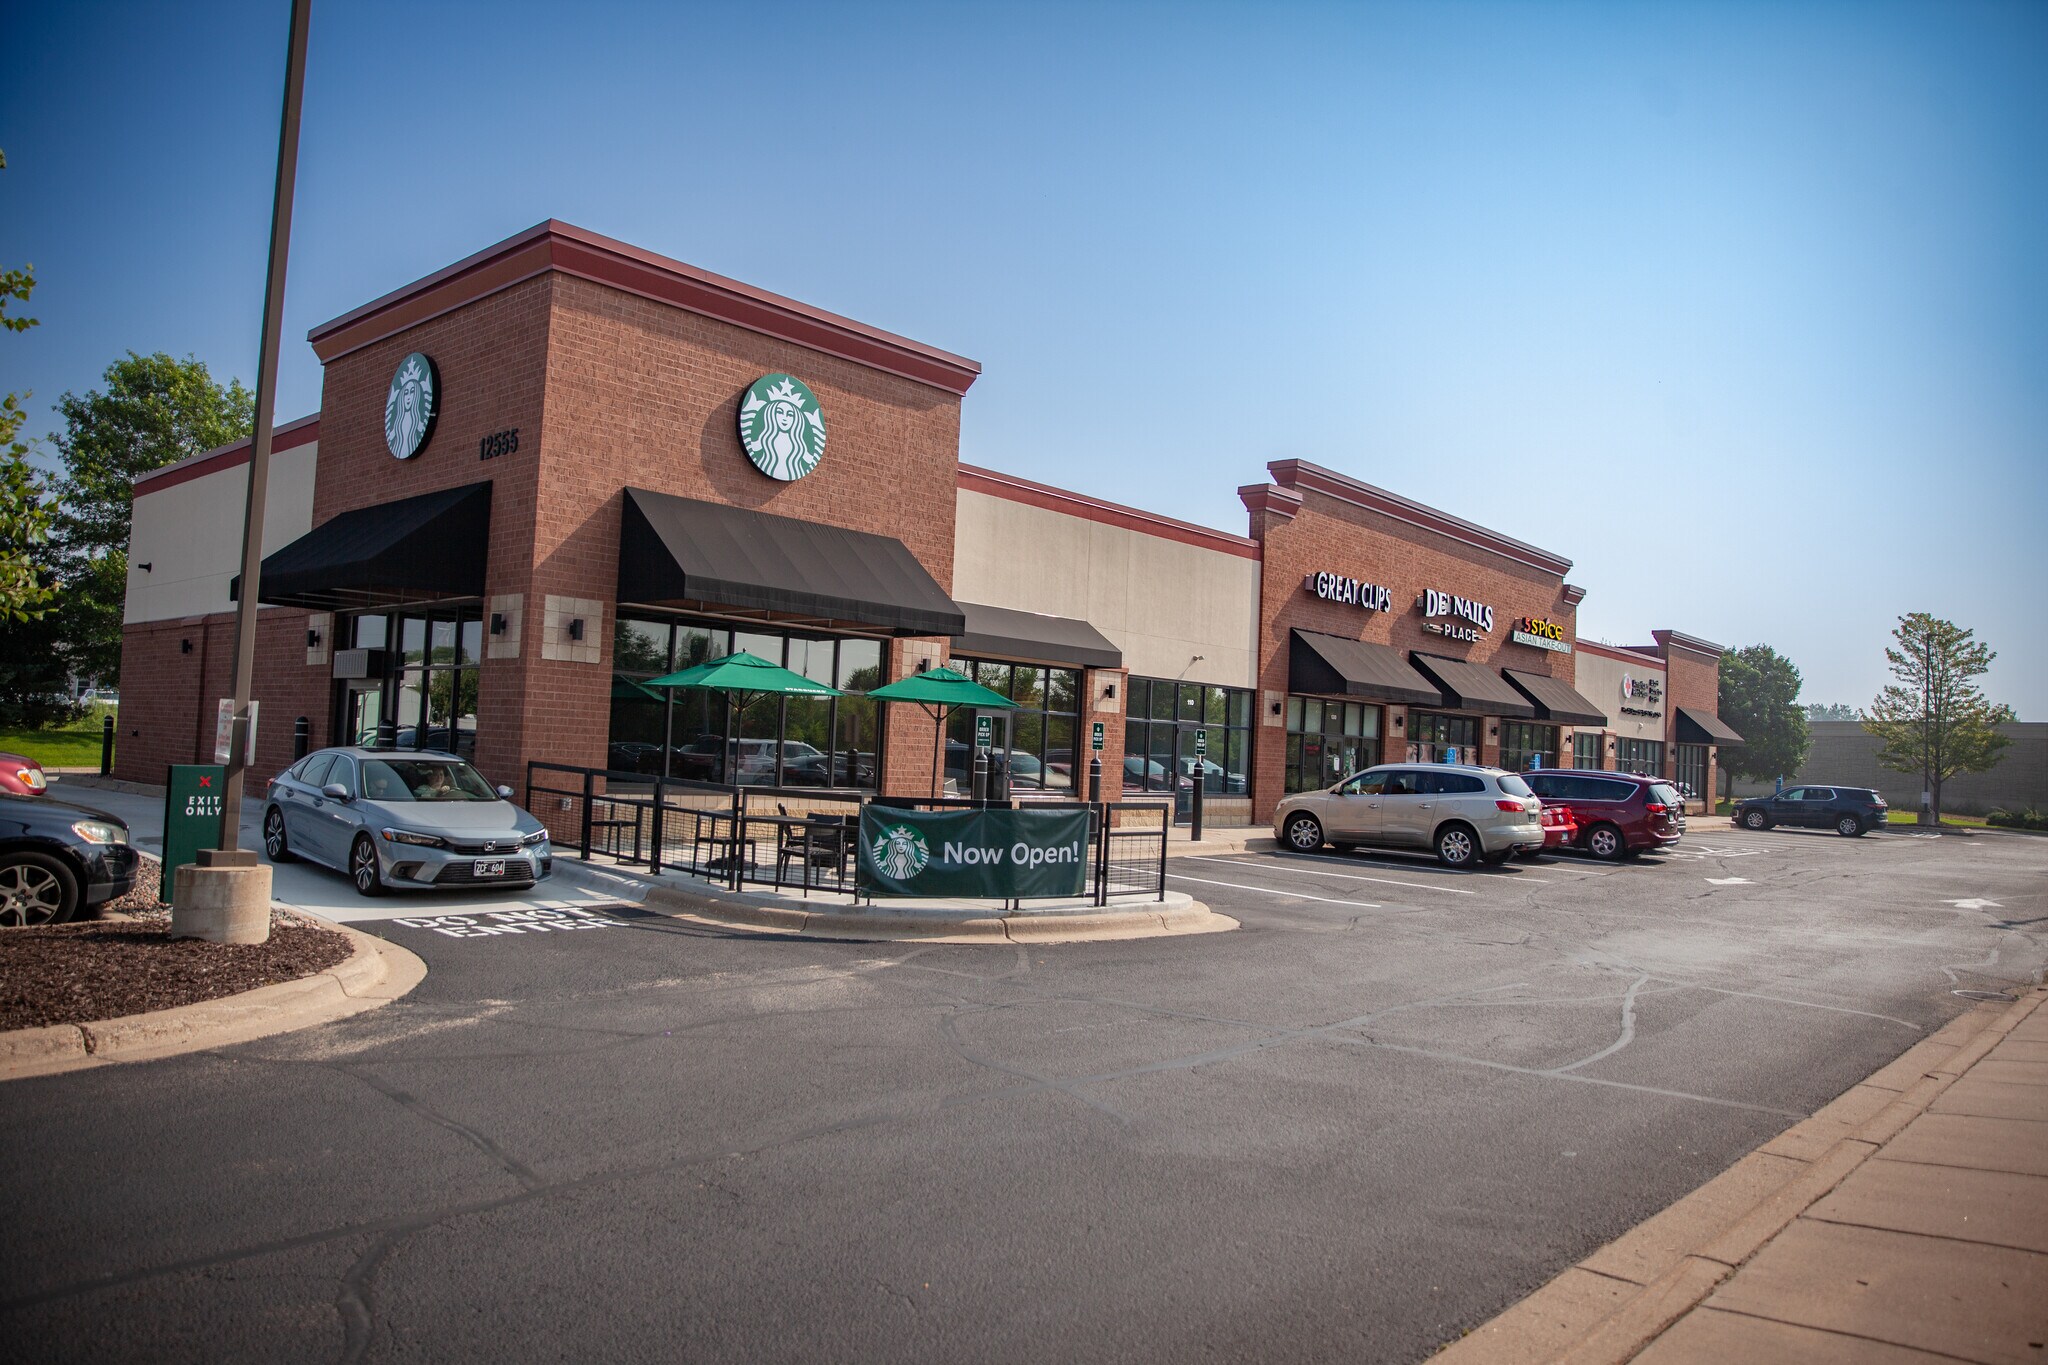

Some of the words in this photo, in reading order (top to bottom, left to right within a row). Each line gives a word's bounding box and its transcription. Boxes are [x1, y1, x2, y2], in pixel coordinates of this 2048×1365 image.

[480, 427, 519, 461] 12555
[1316, 571, 1358, 605] GREAT
[1360, 582, 1392, 613] CLIPS
[1453, 595, 1493, 633] NAILS
[1443, 623, 1478, 642] PLACE
[1515, 632, 1538, 645] ASIAN
[1538, 637, 1571, 653] TAKE-OUT
[185, 806, 222, 816] ONLY
[188, 796, 221, 806] EXIT
[943, 841, 1004, 865] Now
[1010, 840, 1079, 870] Open!
[392, 915, 478, 928] DO
[486, 907, 594, 923] NOT
[433, 918, 630, 938] ENTER
